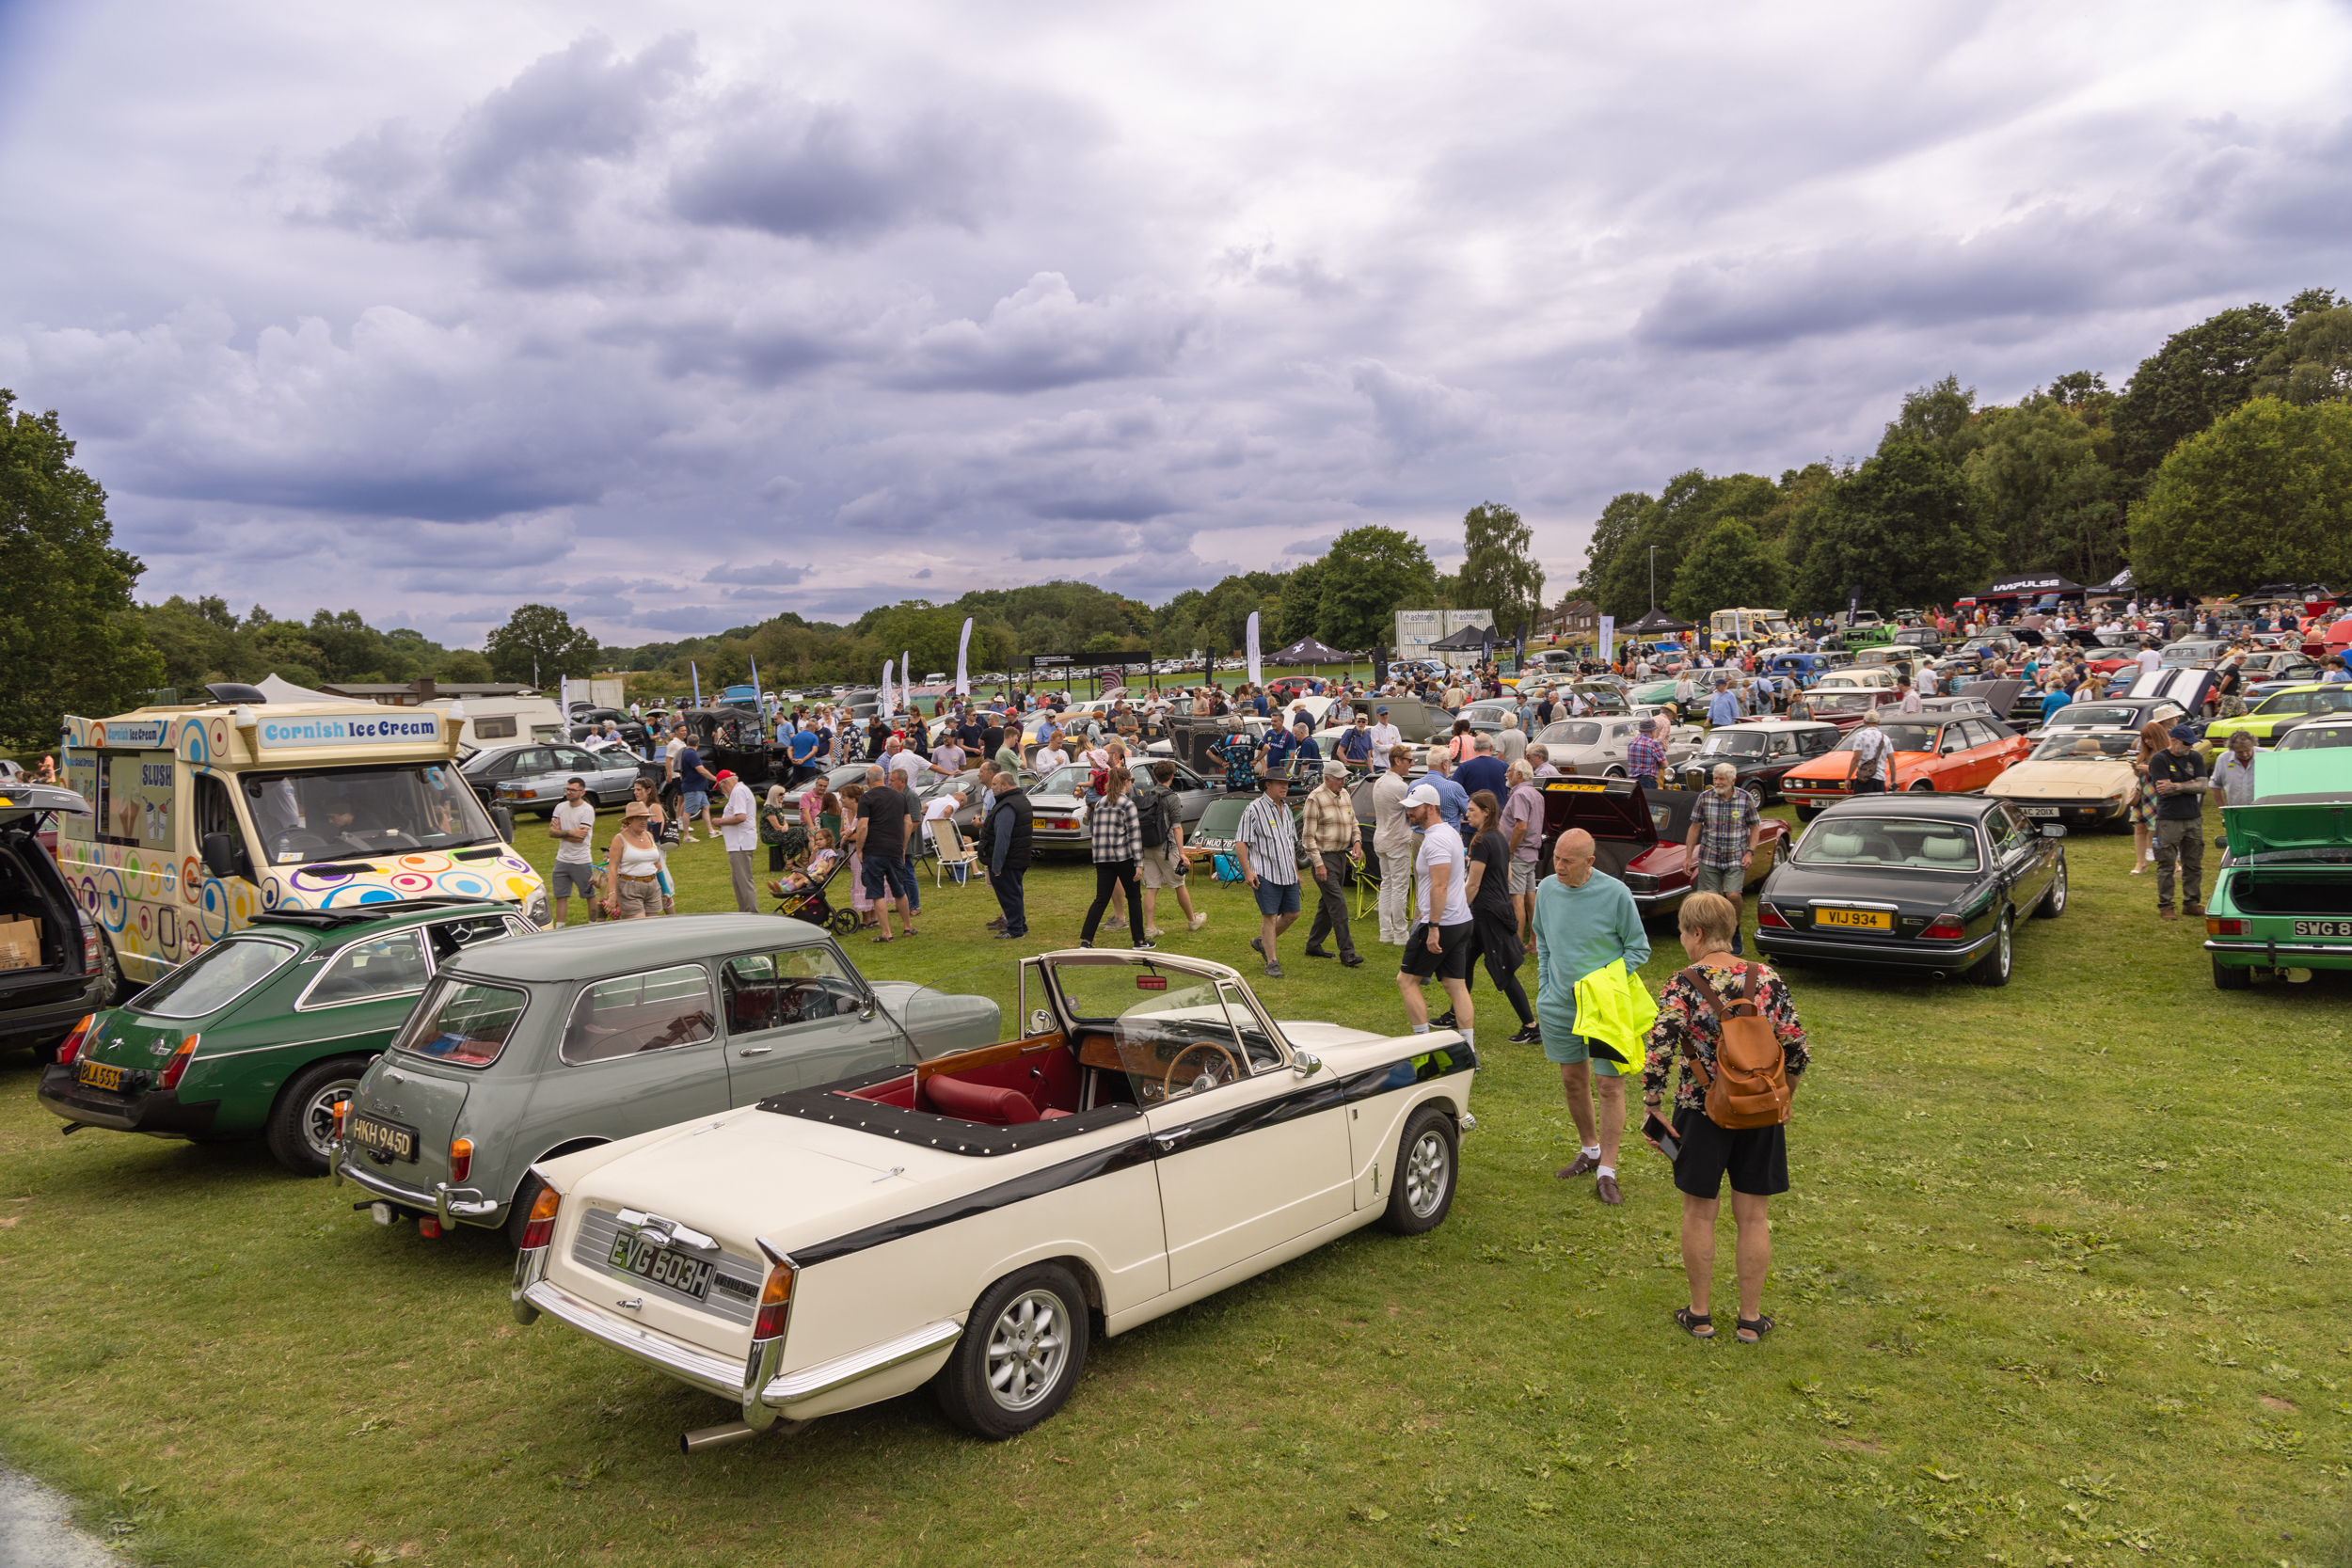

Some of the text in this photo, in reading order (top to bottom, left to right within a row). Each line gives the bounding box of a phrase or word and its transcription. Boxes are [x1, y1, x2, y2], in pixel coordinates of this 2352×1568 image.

[1993, 578, 2059, 593] IMPULSE
[107, 728, 158, 741] Cornish Ice Cream
[265, 720, 436, 741] Cornish Ice Cream
[142, 763, 172, 788] SLUSH
[1829, 911, 1877, 926] VIJ 934
[2296, 922, 2352, 935] SWG 8
[354, 1118, 410, 1156] HKH 945D
[610, 1233, 712, 1298] EVG 603H
[715, 1274, 758, 1297] TRIUMPH
